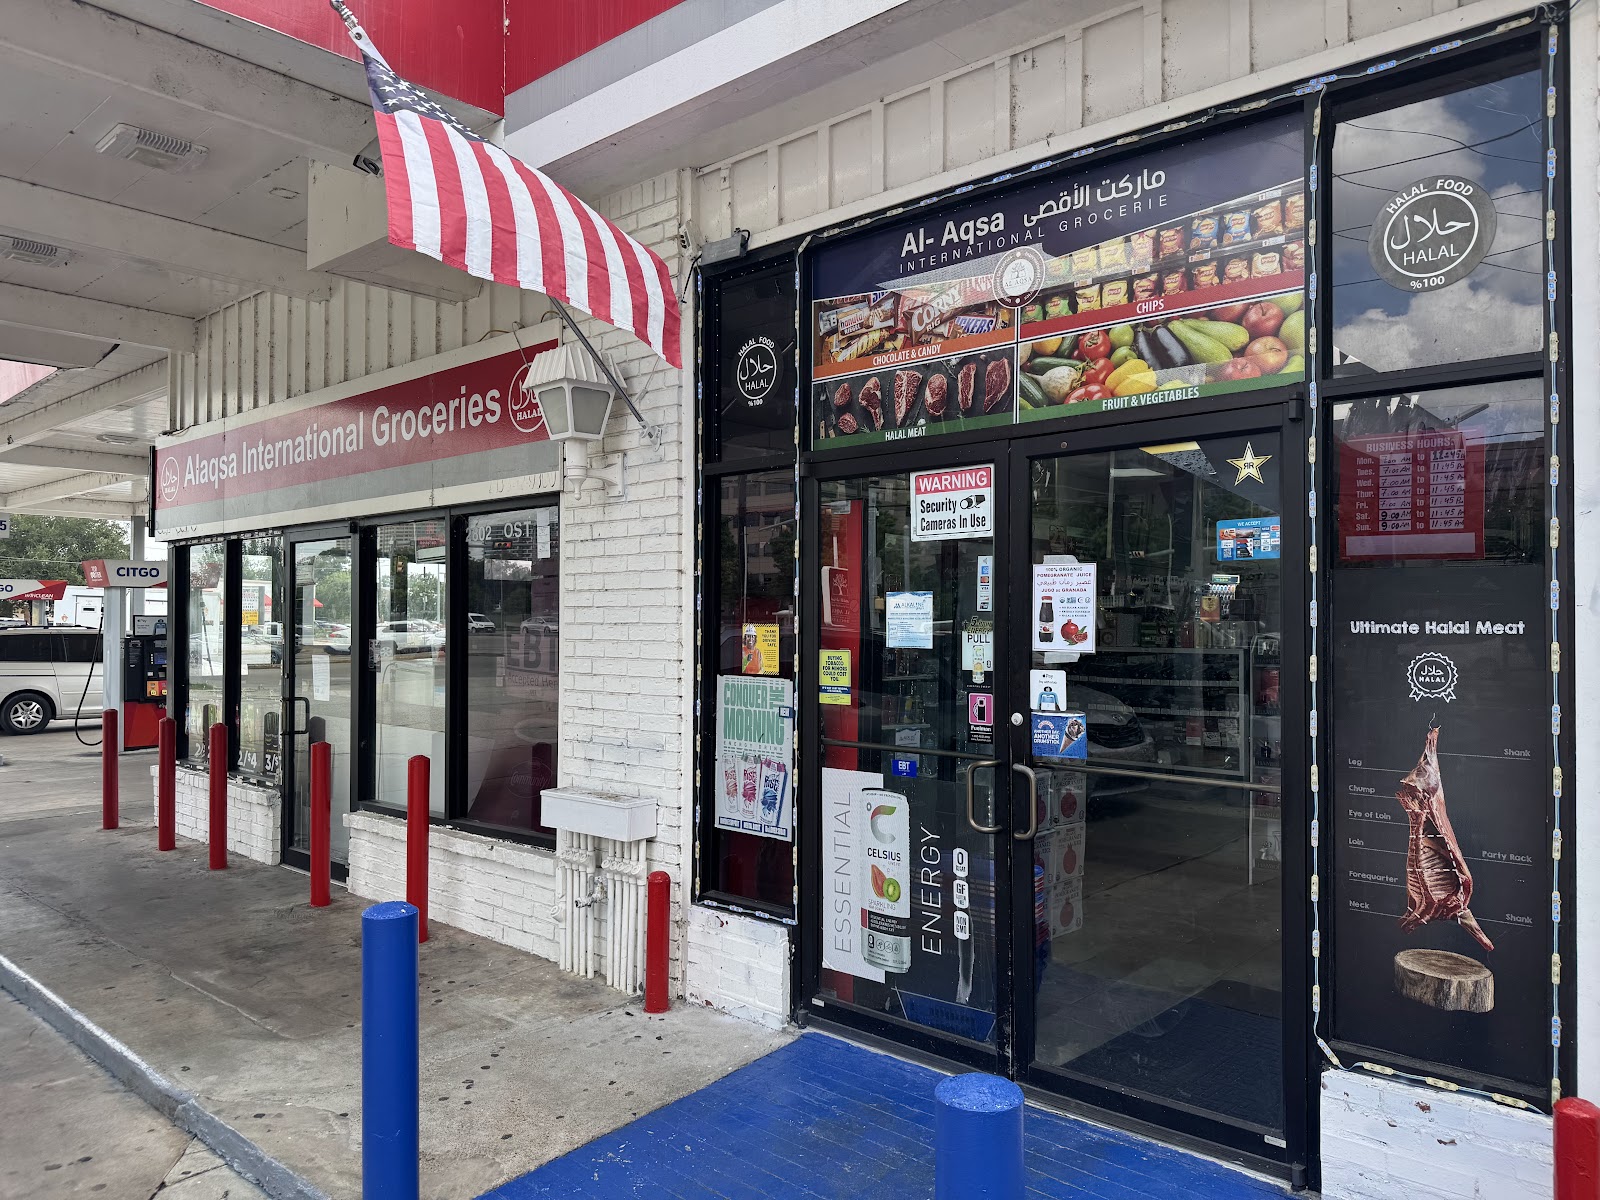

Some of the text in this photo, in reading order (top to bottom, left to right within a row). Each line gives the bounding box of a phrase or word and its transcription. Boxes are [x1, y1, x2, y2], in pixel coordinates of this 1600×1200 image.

[1023, 168, 1166, 228] ماركت الأقصى
[1386, 179, 1474, 214] HALAL FOOD
[900, 228, 1045, 274] INTERNATIONAL
[1059, 194, 1168, 232] GROCERIE
[941, 212, 1005, 247] Aqsa
[1390, 207, 1472, 250] حلال
[1403, 243, 1459, 266] HALAL
[1410, 275, 1445, 290] %100
[1136, 299, 1165, 314] CHIPS
[737, 336, 775, 357] HALAL FOOD
[872, 343, 942, 366] CHOCOLATE & CANDY
[740, 354, 774, 381] حلال
[745, 378, 769, 391] HALAL
[1102, 387, 1200, 411] FRUIT & VEGETABLES
[184, 385, 501, 489] Alaqsa International Groceries
[885, 426, 927, 442] HALAL MEAT
[1366, 440, 1414, 453] BUSINESS
[1356, 457, 1374, 465] Mon.
[1356, 468, 1375, 476] Tues.
[919, 470, 988, 492] WARNING
[1356, 479, 1374, 487] Wed.
[1416, 475, 1425, 483] to
[1356, 490, 1375, 498] Thur.
[1416, 487, 1425, 495] to
[920, 497, 957, 514] Security
[1416, 498, 1425, 506] to
[920, 513, 986, 531] Cameras In Use
[1355, 512, 1371, 520] Sat.
[1355, 523, 1372, 531] Sun.
[1416, 521, 1425, 529] to
[465, 525, 492, 543] 2802
[116, 566, 160, 578] CITGO
[1350, 620, 1526, 635] Ultimate Halal Meat
[967, 634, 991, 644] PULL
[507, 672, 539, 687] Accepted
[724, 682, 785, 710] CONQUER THE
[723, 707, 785, 746] MORNING
[758, 744, 783, 752] DRINK
[1503, 748, 1531, 757] Shank
[237, 750, 257, 769] 2/$4
[898, 760, 910, 770] EBT
[1348, 758, 1362, 767] Leg
[1348, 784, 1376, 794] Chump
[1348, 809, 1391, 820] Eye of Loin
[1348, 837, 1364, 846] Loin
[867, 847, 901, 861] CELSIUS
[957, 851, 964, 866] 0
[1481, 850, 1532, 863] Party Rack
[834, 792, 851, 954] ESSENTIAL
[1349, 870, 1399, 883] Forequarter
[921, 822, 942, 956] ENERGY
[956, 882, 966, 895] GF
[868, 898, 896, 911] SPARKLING
[1349, 900, 1370, 910] Neck
[956, 915, 967, 926] NON
[1505, 913, 1533, 924] Shank
[956, 924, 967, 934] GMO
